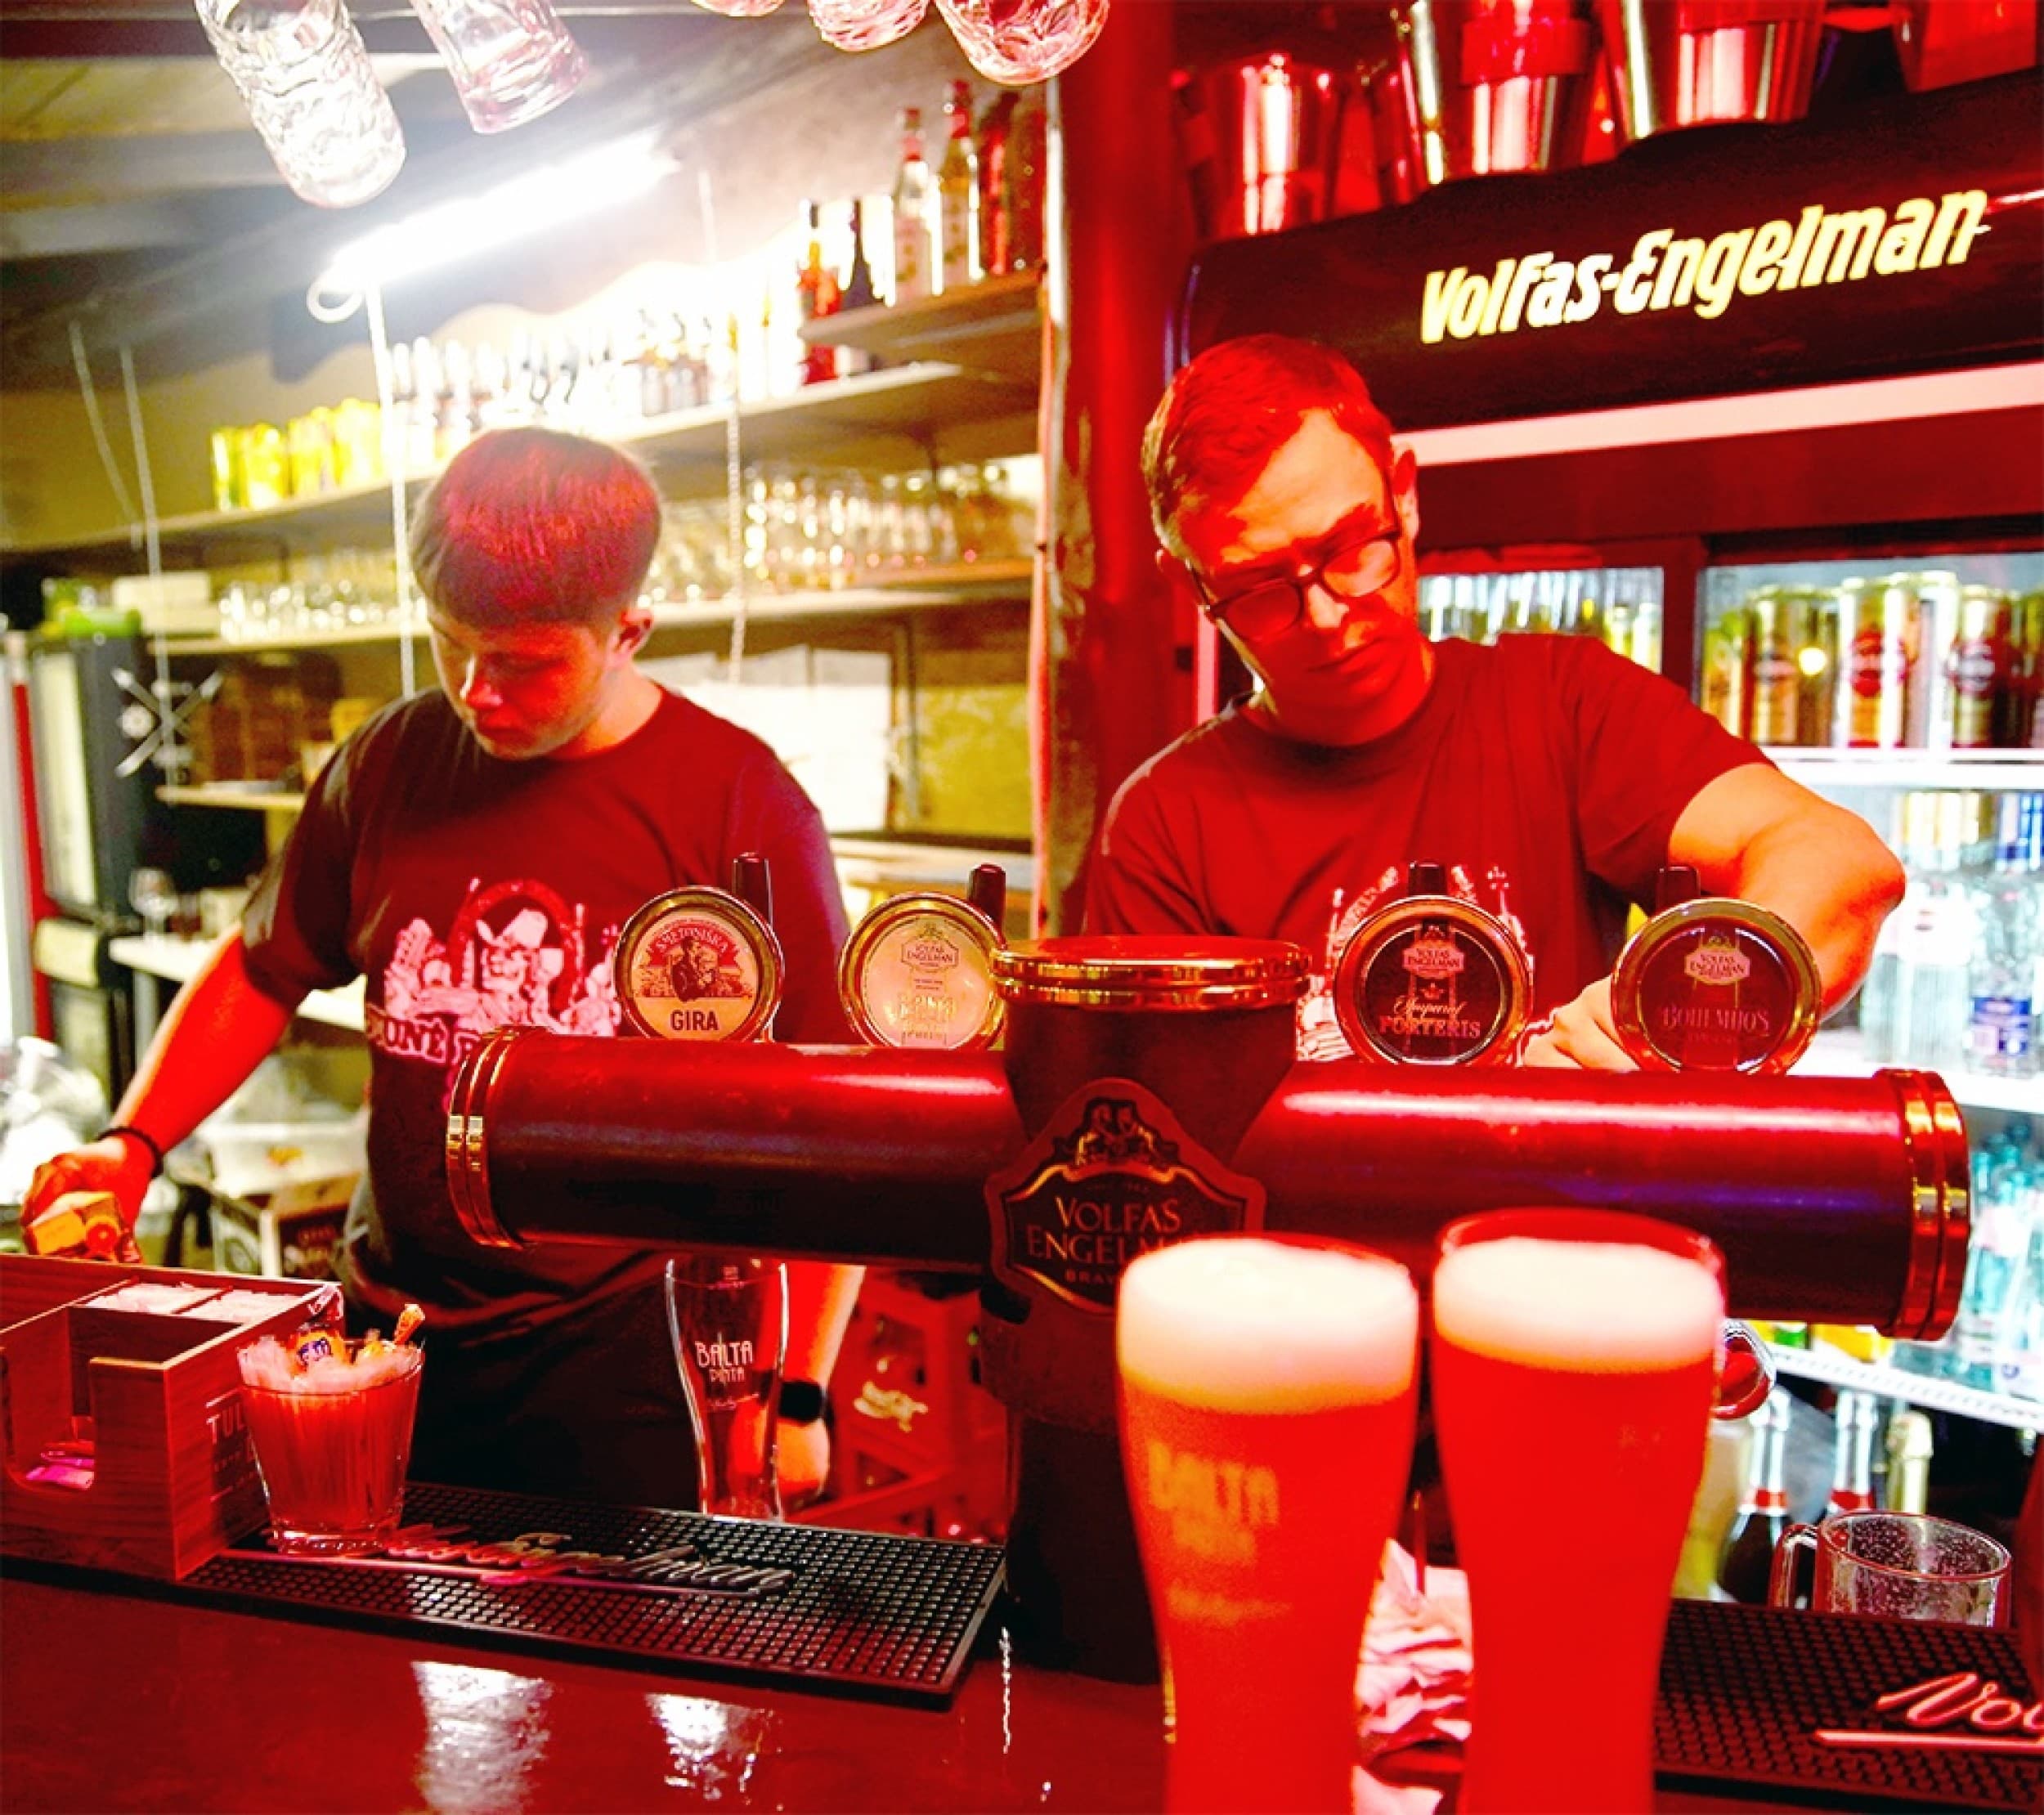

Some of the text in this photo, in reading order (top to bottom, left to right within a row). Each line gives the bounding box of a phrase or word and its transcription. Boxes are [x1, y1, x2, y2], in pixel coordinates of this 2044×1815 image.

[670, 1010, 719, 1031] GIRA
[1056, 1196, 1182, 1235] VOLFAS
[695, 1341, 753, 1368] BALTA
